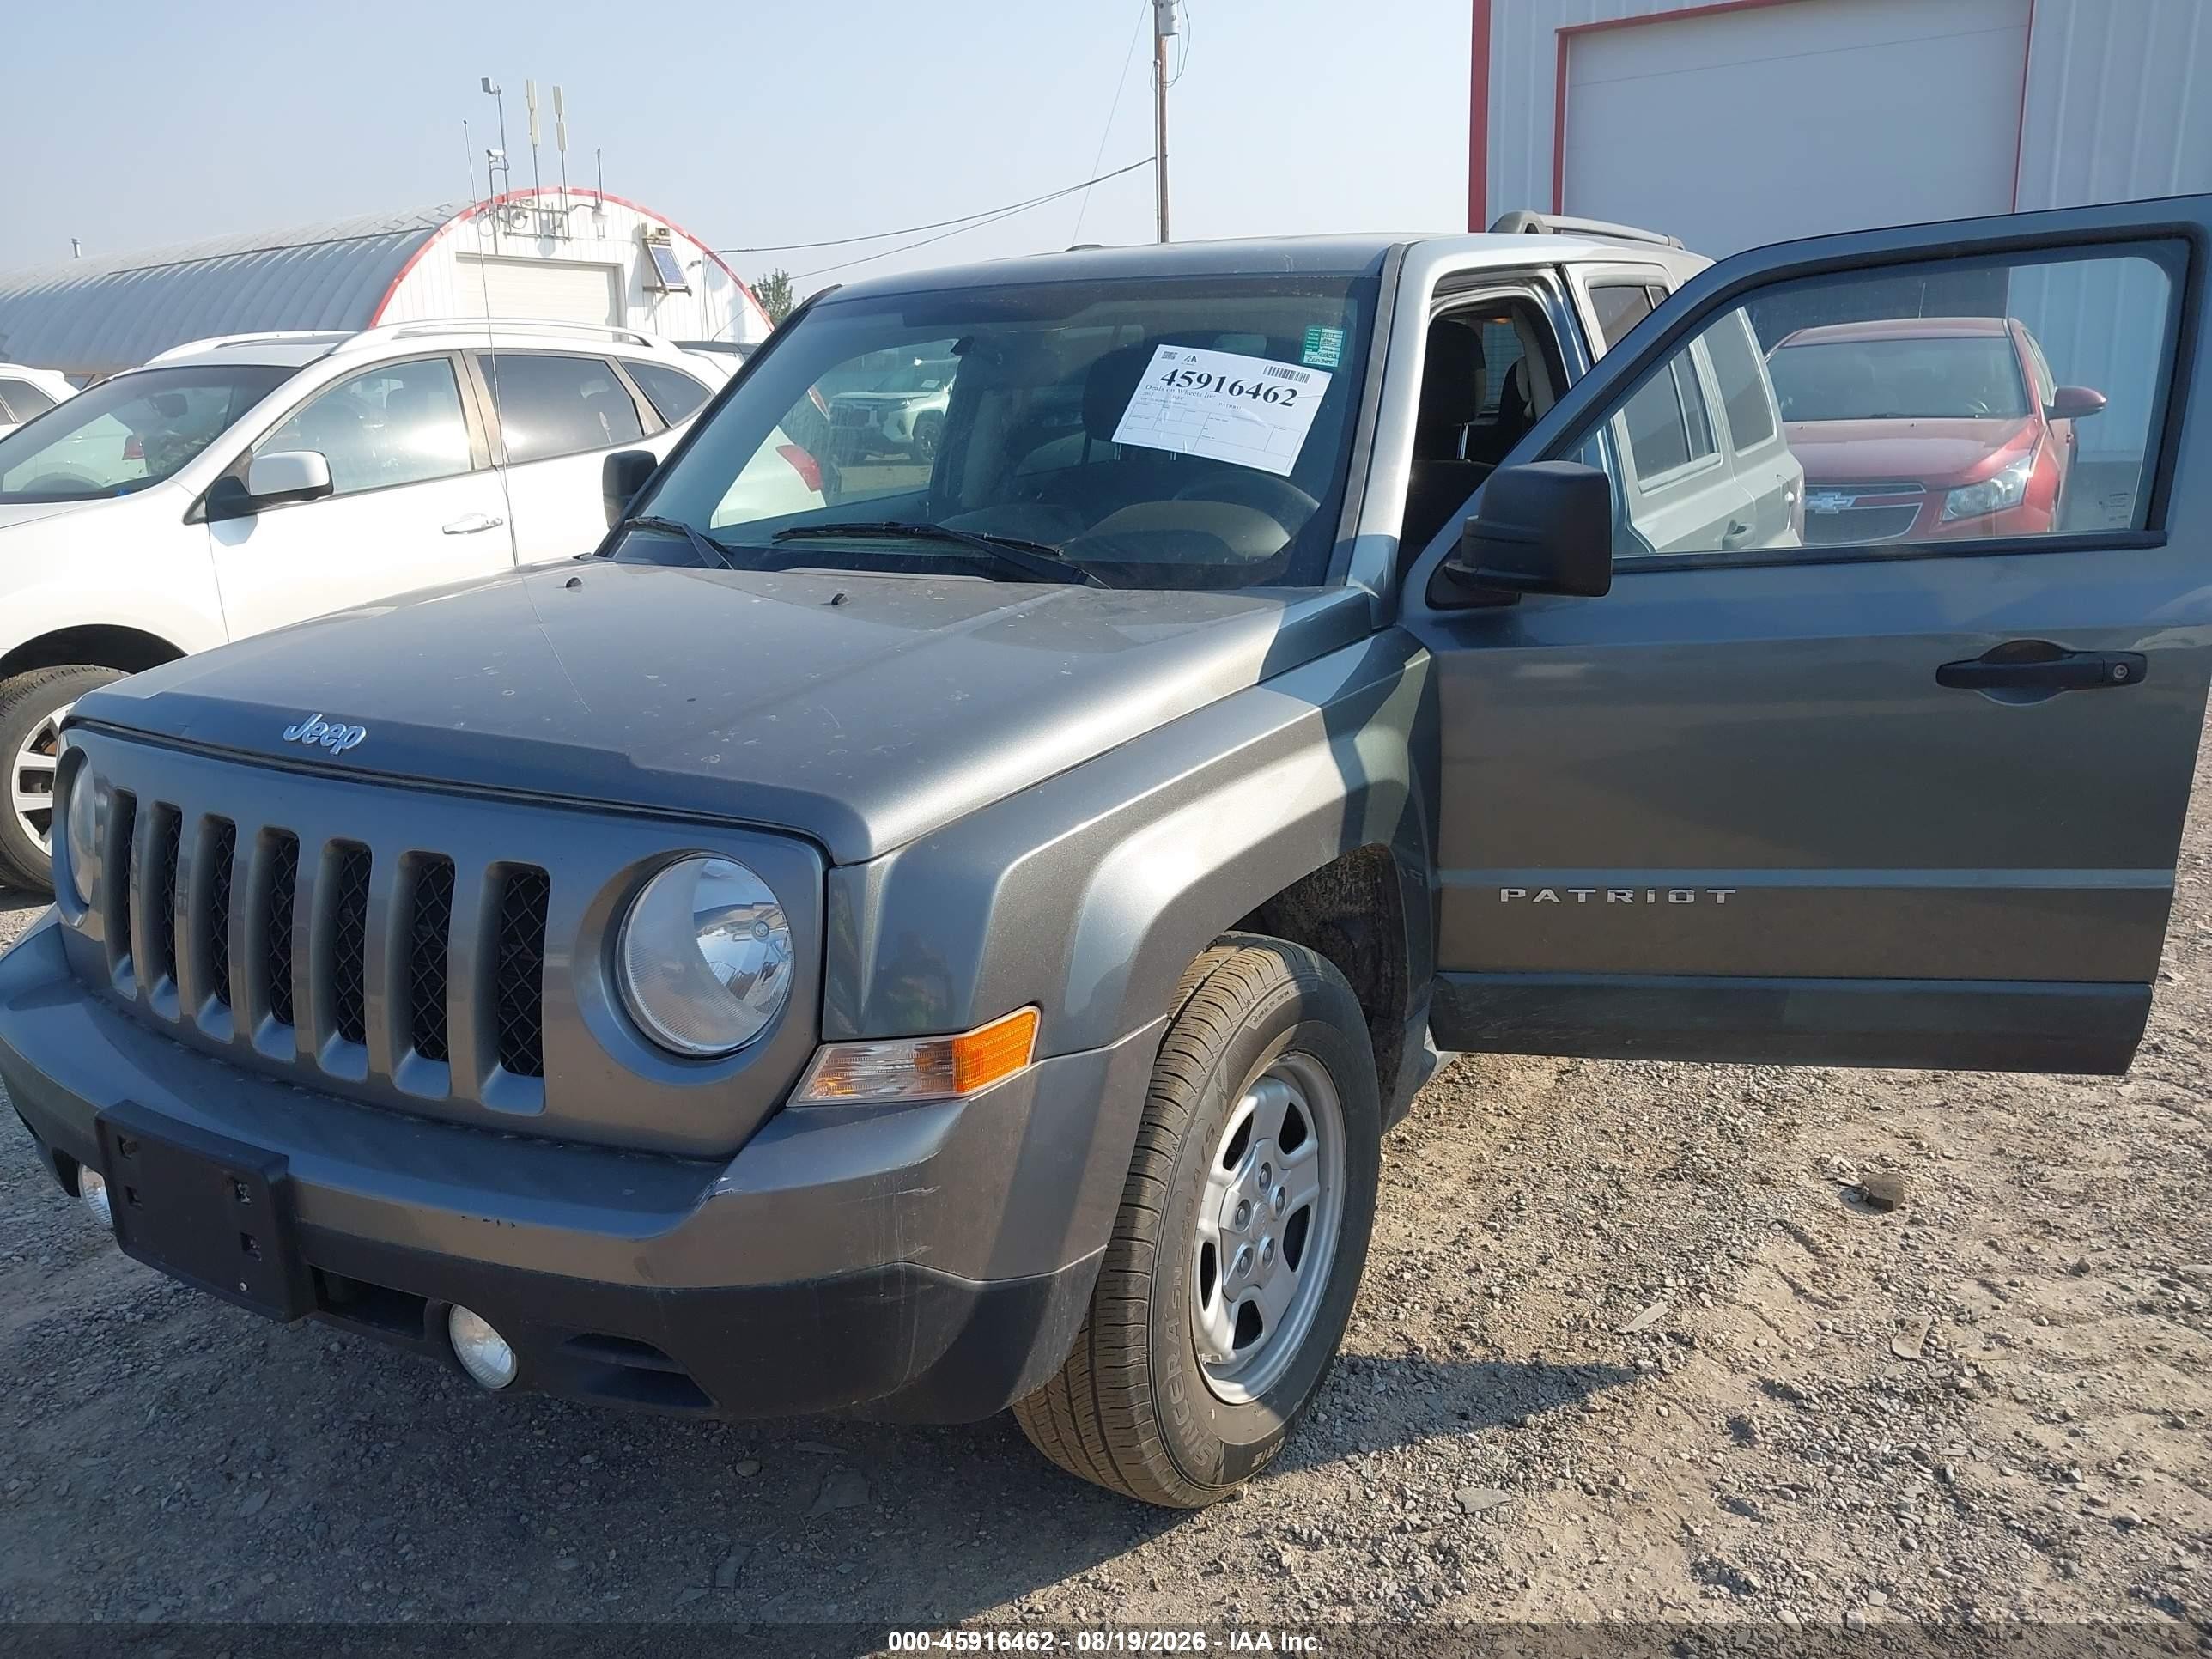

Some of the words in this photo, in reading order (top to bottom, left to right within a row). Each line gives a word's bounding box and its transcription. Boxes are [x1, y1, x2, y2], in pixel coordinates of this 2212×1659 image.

[1160, 368, 1298, 407] 45916462
[283, 713, 367, 755] Jeep
[1500, 888, 1737, 904] PATRIOT
[1165, 1319, 1215, 1467] SINCERA
